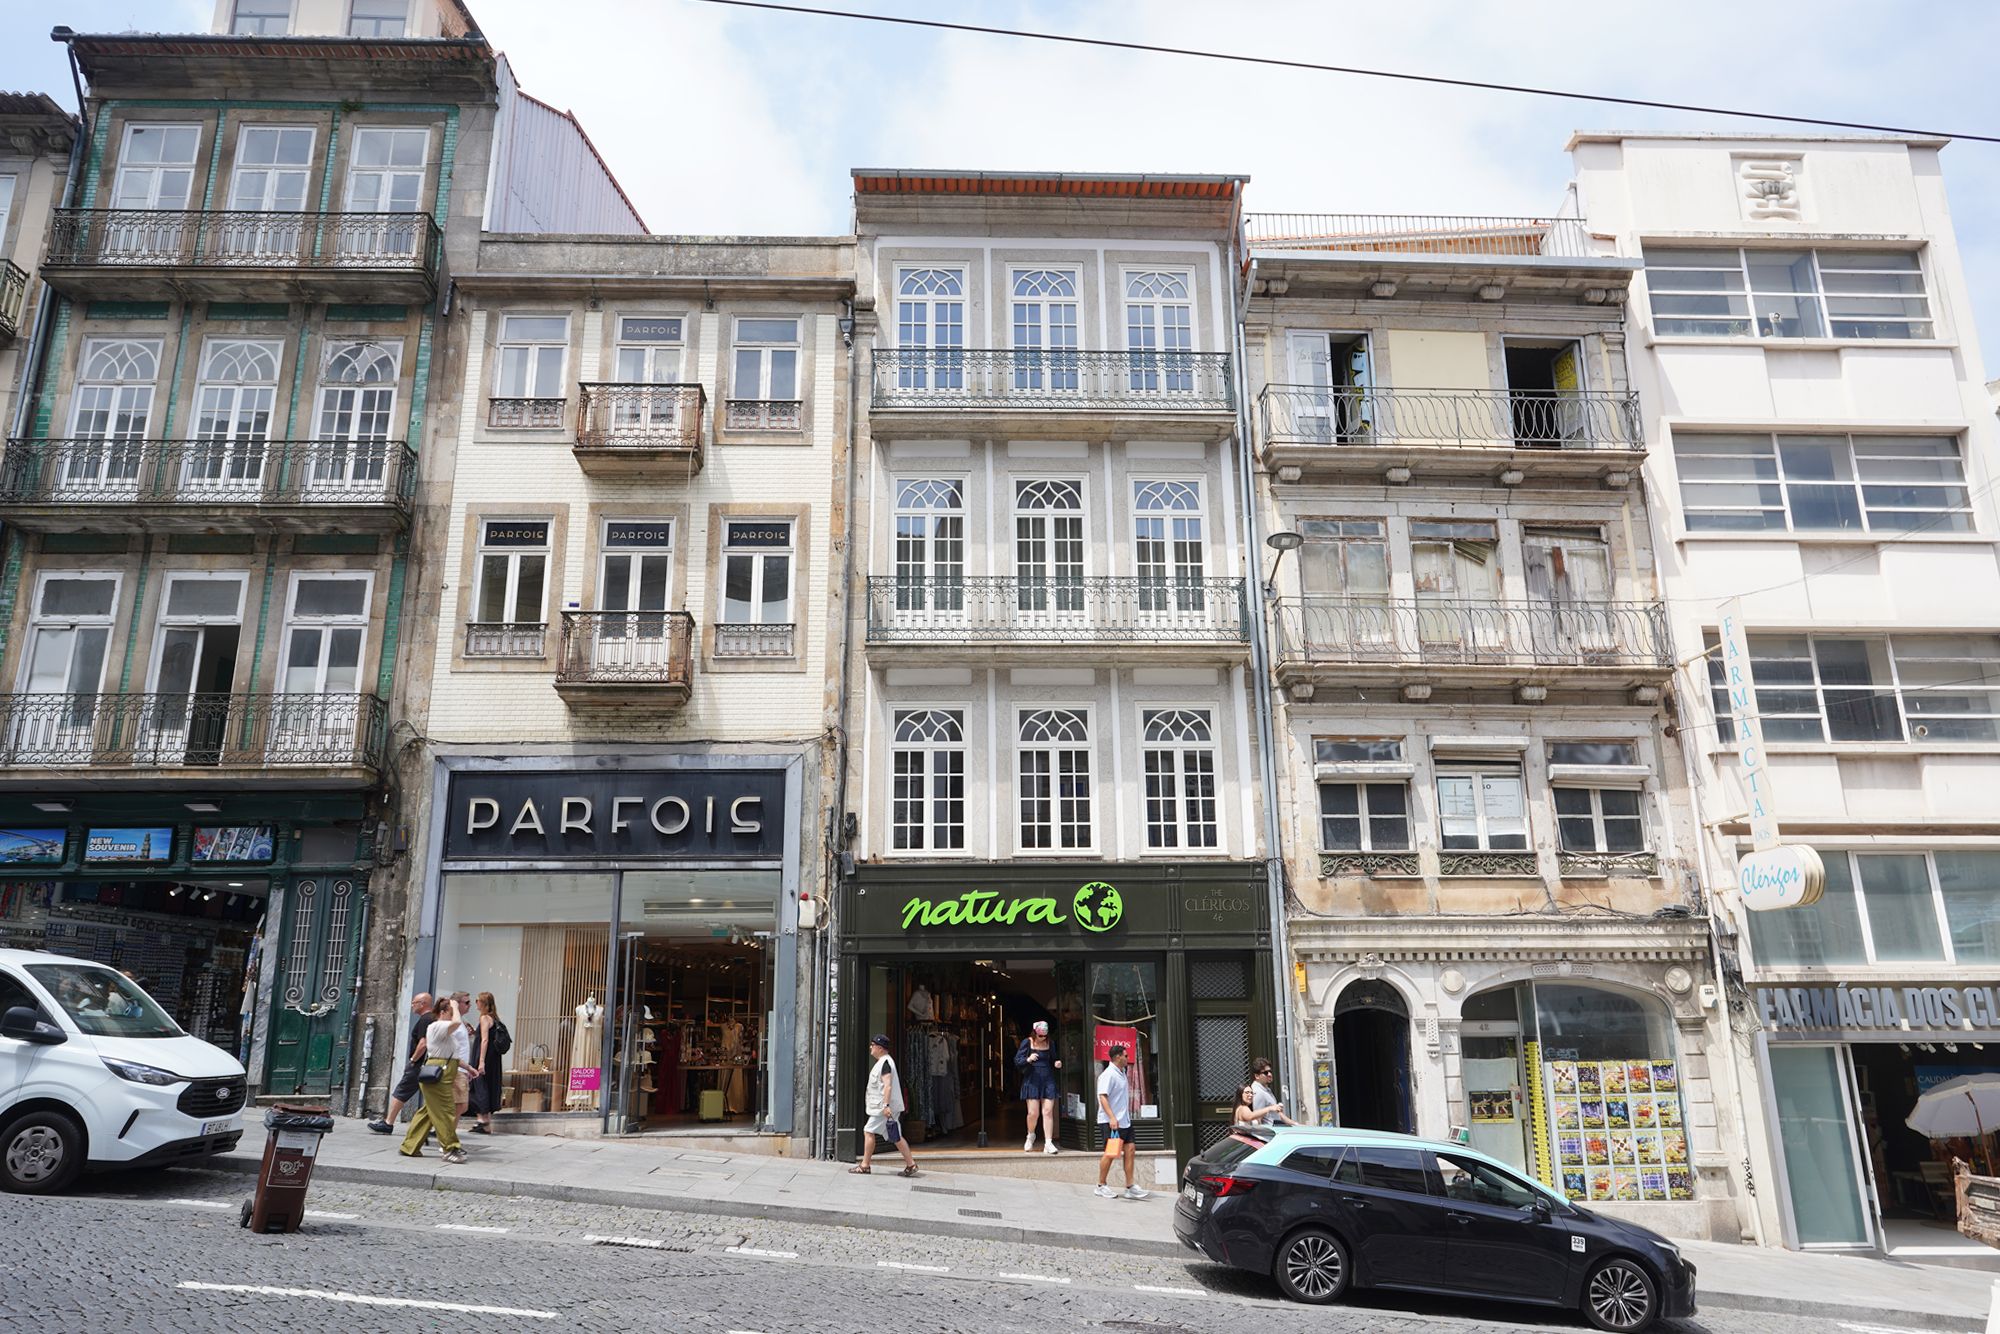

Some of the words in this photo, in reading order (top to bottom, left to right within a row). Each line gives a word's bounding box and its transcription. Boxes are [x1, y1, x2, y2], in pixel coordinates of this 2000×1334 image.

[626, 326, 679, 335] PARFOIS
[490, 530, 544, 539] PARFOIS
[611, 530, 665, 540] PARFOIS
[733, 531, 786, 540] PARFOIS
[1723, 616, 1765, 819] FARMÁCIA
[466, 795, 761, 835] PARFOIS
[90, 837, 113, 845] NEW
[1741, 864, 1800, 897] Clérigos
[1209, 889, 1225, 897] THE
[1185, 896, 1250, 911] CLÉRIGOS
[901, 889, 1067, 930] natura
[1212, 913, 1224, 922] 46
[1757, 981, 1901, 1028] FARMÁCIA
[1902, 987, 1964, 1027] DOS
[1963, 986, 2000, 1027] CL
[1100, 1039, 1131, 1048] SALDOS
[1573, 1237, 1584, 1245] 339
